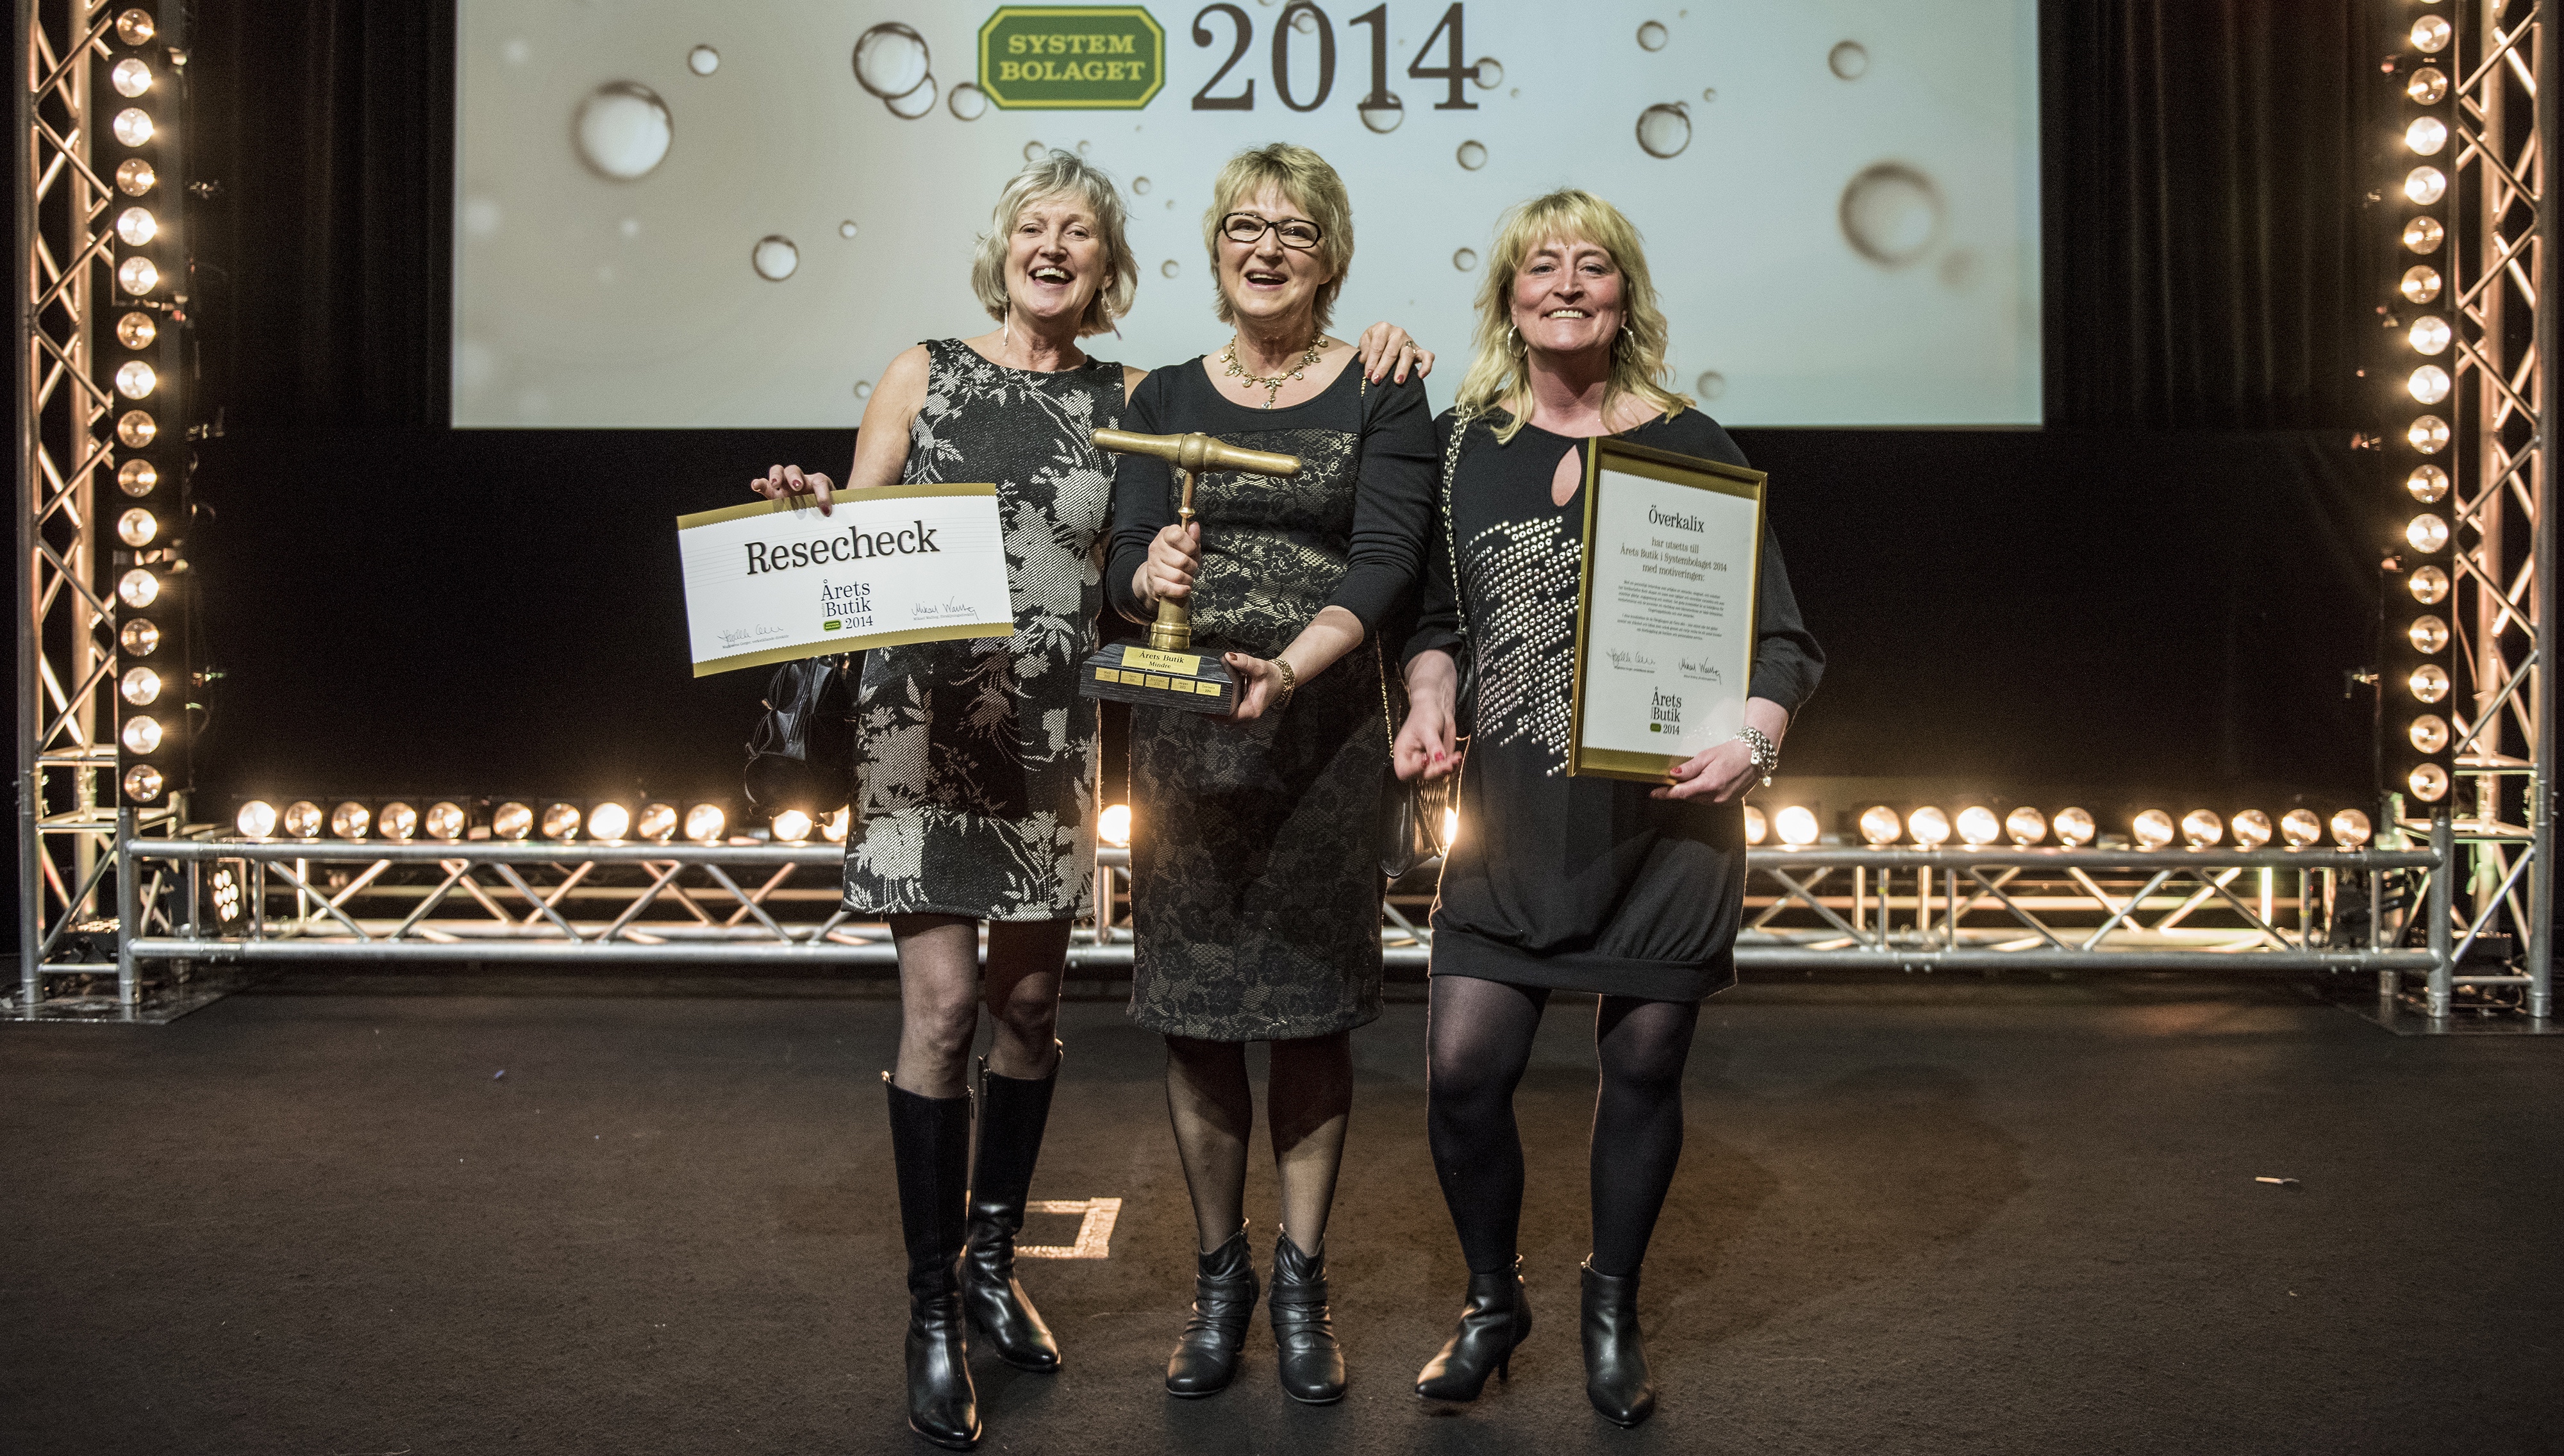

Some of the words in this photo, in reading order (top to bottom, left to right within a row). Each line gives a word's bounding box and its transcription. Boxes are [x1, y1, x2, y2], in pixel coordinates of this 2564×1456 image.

[1008, 34, 1135, 54] SYSTEM
[1192, 2, 1480, 112] 2014
[999, 61, 1146, 82] BOLAGET
[1649, 504, 1704, 533] Överkalix
[744, 520, 940, 575] Resecheck
[1652, 536, 1664, 548] har
[1666, 540, 1688, 552] utsetts
[1690, 543, 1699, 554] till
[1620, 542, 1639, 557] Årets
[1640, 549, 1658, 560] Butik
[1664, 552, 1711, 570] Systembolaget
[1713, 561, 1727, 572] 2014
[1642, 564, 1658, 574] med
[1659, 567, 1705, 582] motiveringen:
[820, 579, 870, 601] Årets
[826, 597, 872, 617] Butik
[845, 615, 874, 629] 2014
[1139, 650, 1160, 661] Årets
[1163, 655, 1185, 664] Butik
[1149, 661, 1172, 669] Mindre
[1651, 686, 1682, 709] Årets
[1653, 707, 1681, 723] Butik
[1663, 724, 1680, 735] 2014
